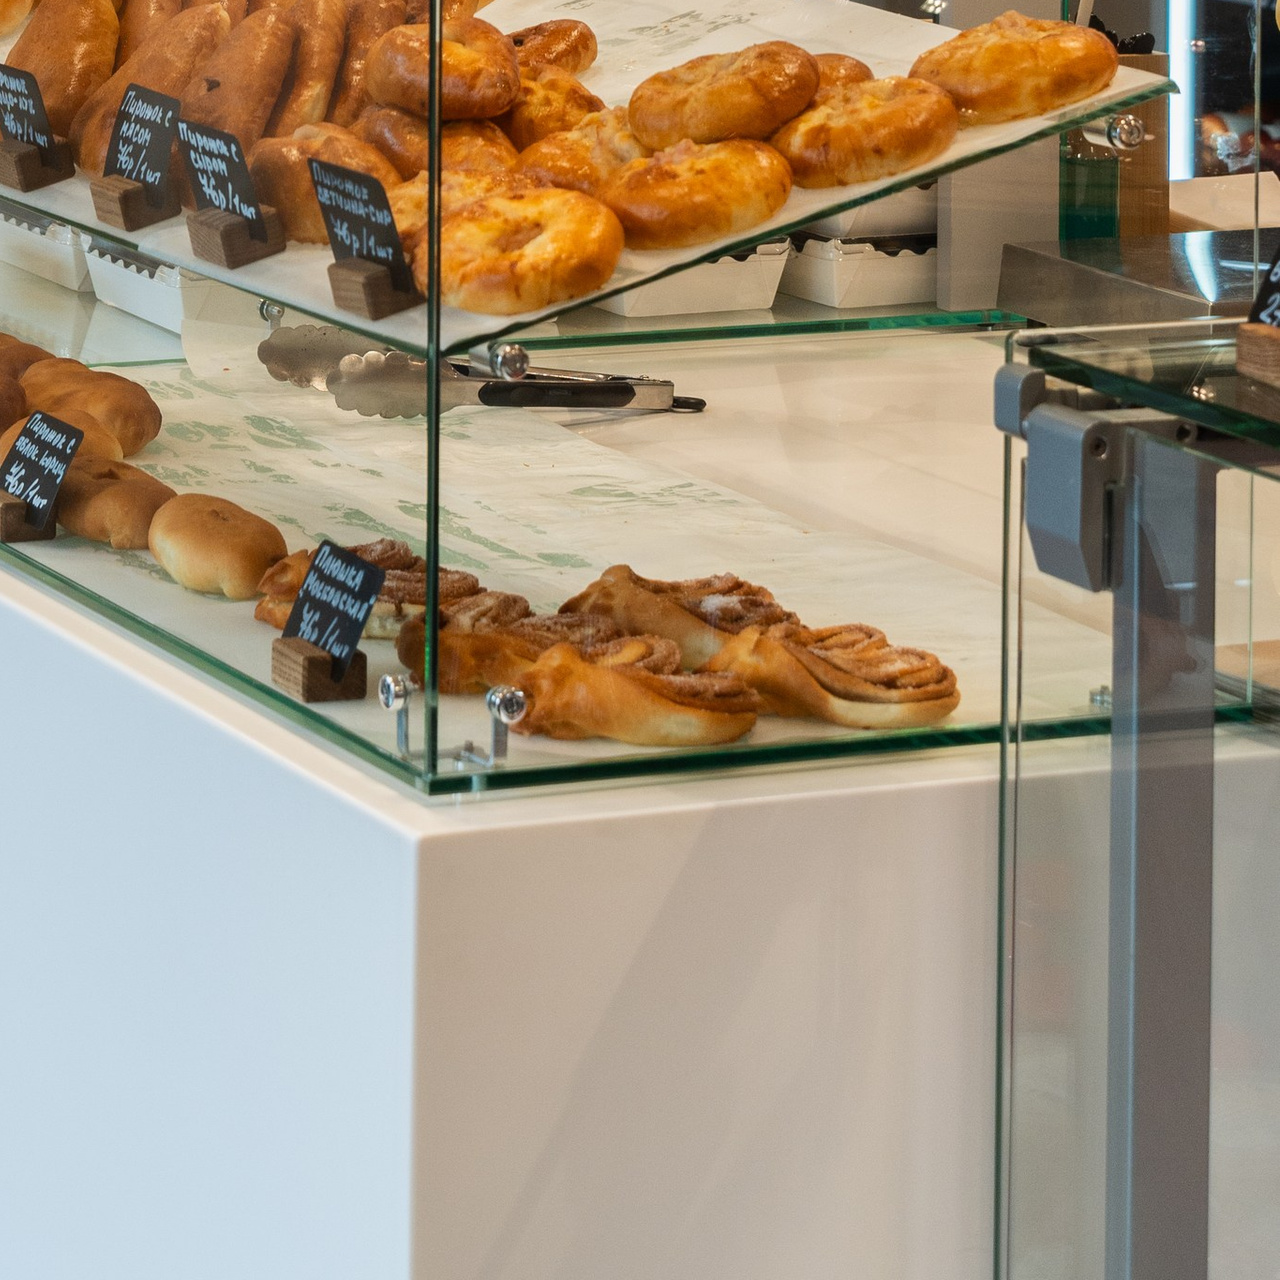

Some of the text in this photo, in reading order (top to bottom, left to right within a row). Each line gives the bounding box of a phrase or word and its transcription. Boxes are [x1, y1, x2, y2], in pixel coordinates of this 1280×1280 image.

[121, 90, 163, 124] Пирожок
[177, 121, 230, 158] Пирожок
[26, 413, 66, 450] Пирожок
